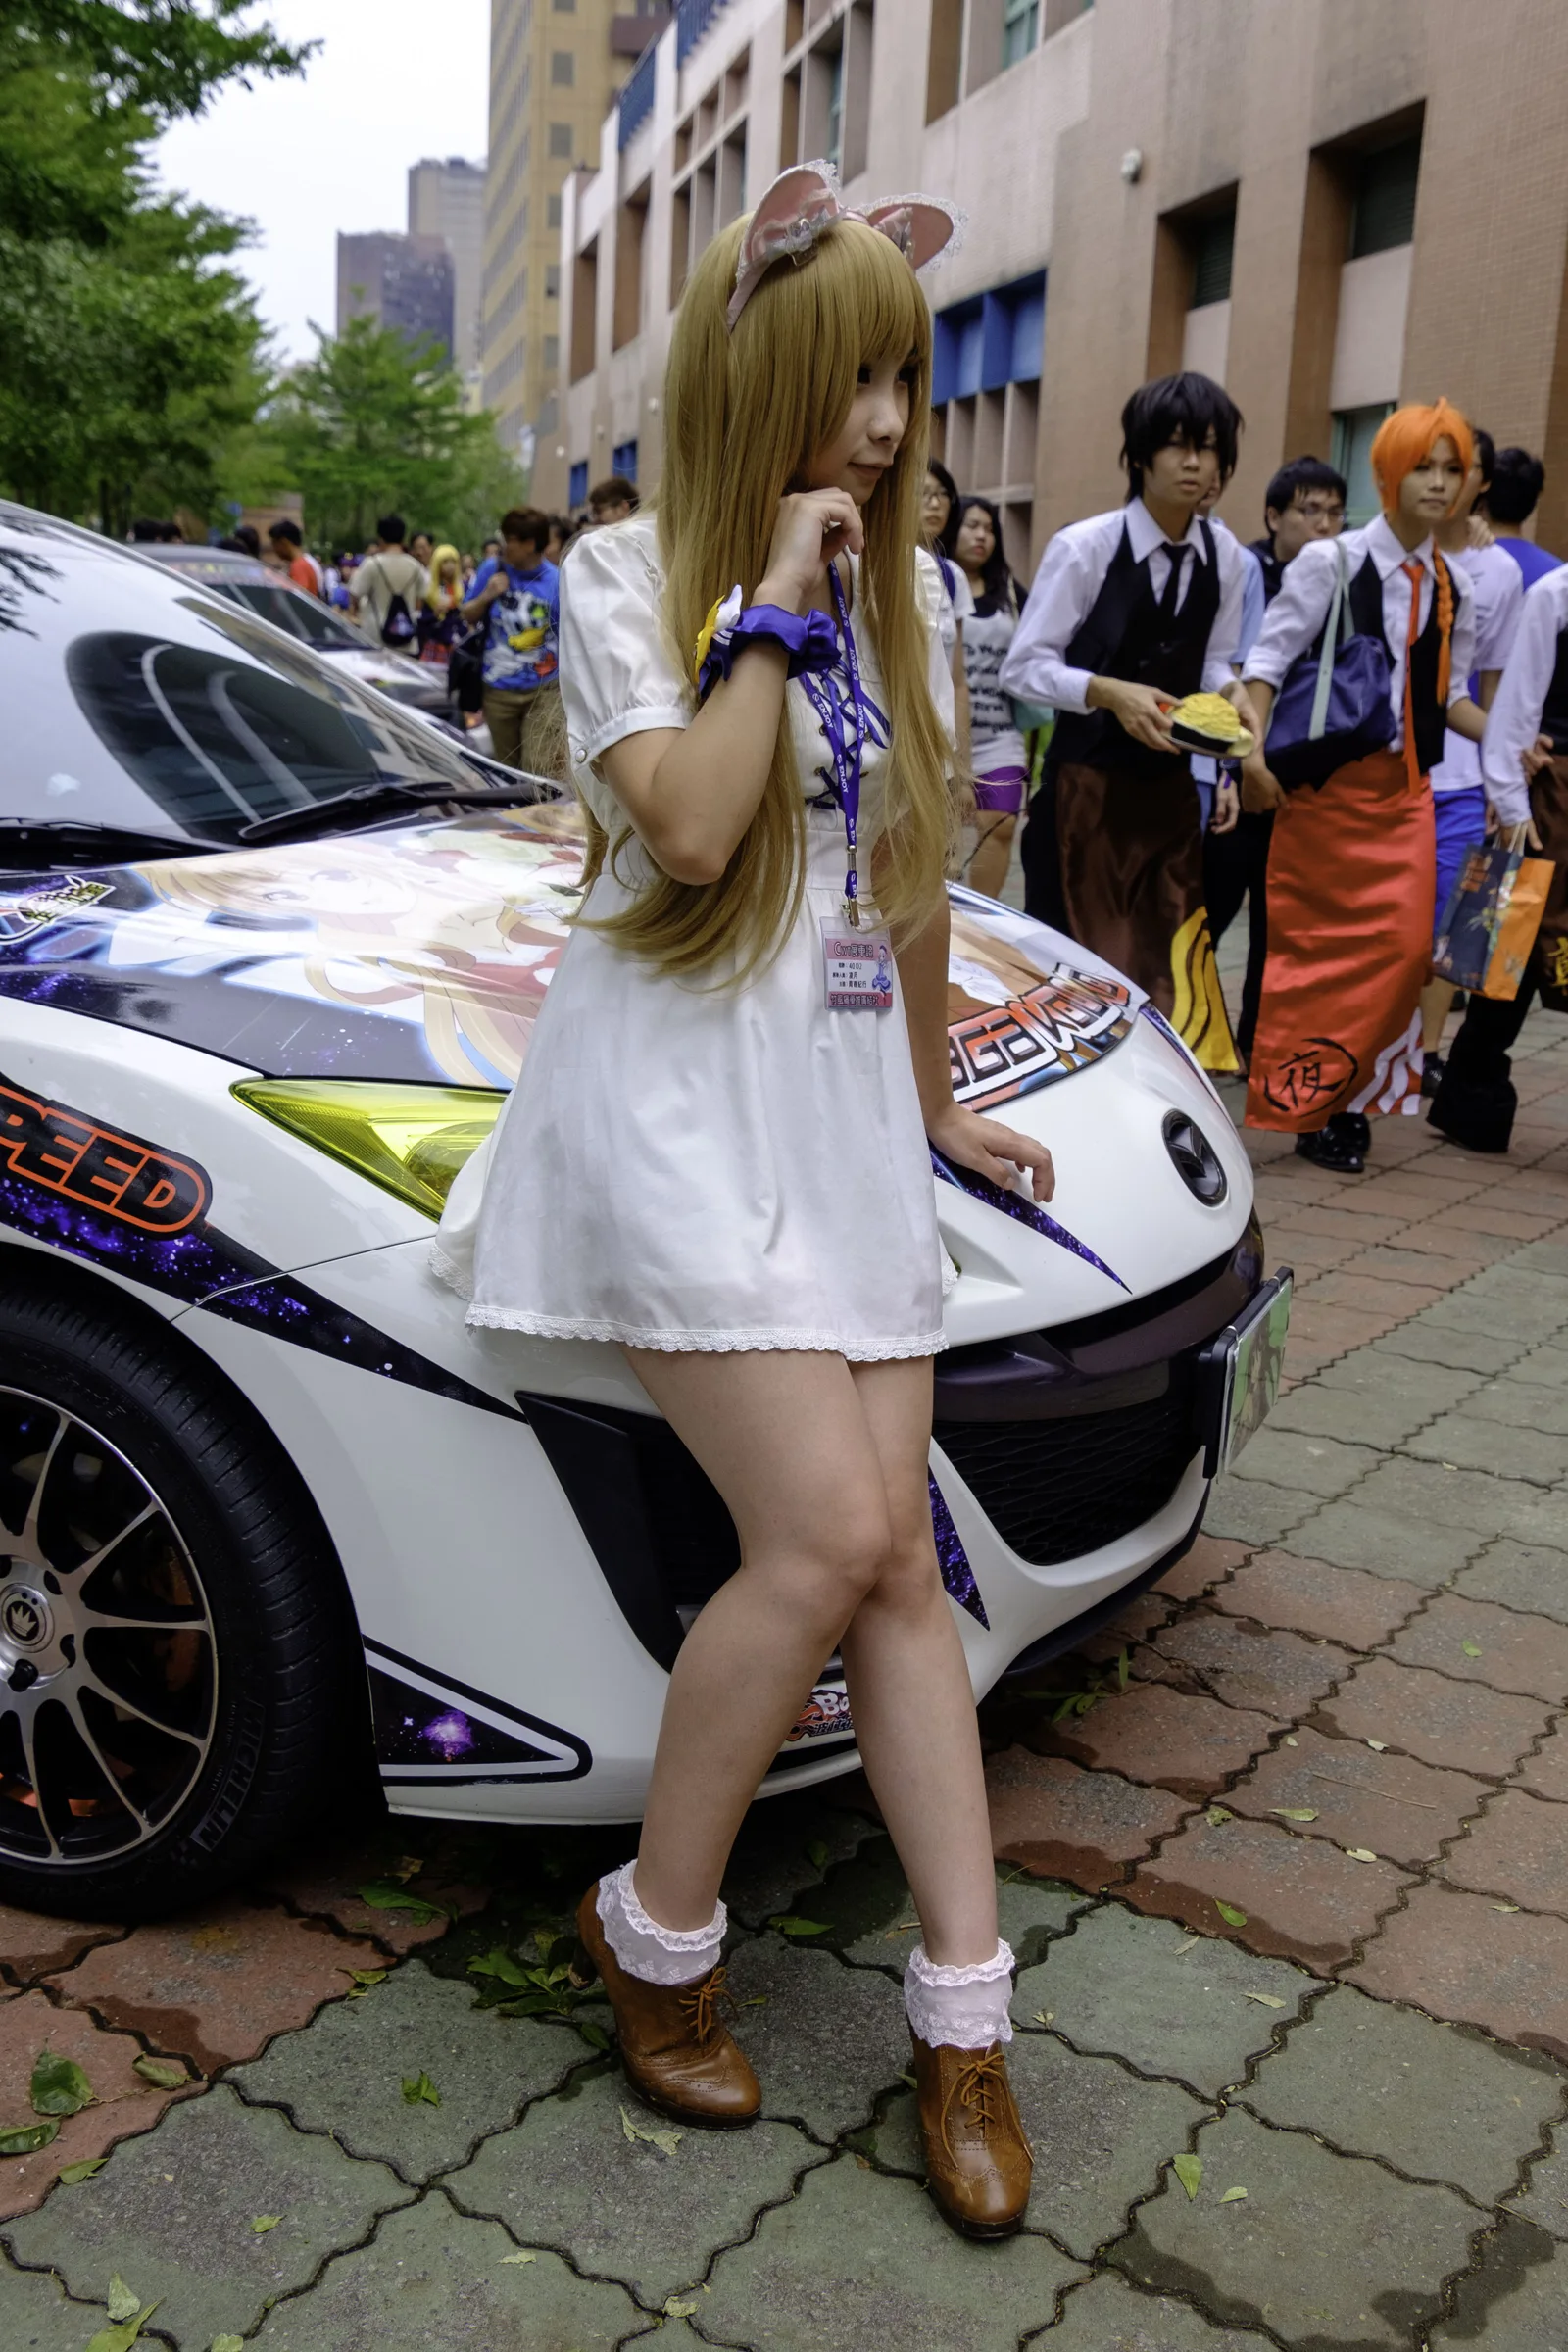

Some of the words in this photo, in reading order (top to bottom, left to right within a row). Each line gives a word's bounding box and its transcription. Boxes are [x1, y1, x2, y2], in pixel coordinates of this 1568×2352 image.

[837, 595, 849, 619] ENJOY
[849, 647, 859, 672] ENJOY
[817, 703, 834, 729] ENJOY
[857, 702, 865, 728] ENJOY
[838, 765, 849, 794] ENJOY
[811, 1692, 850, 1716] Bo
